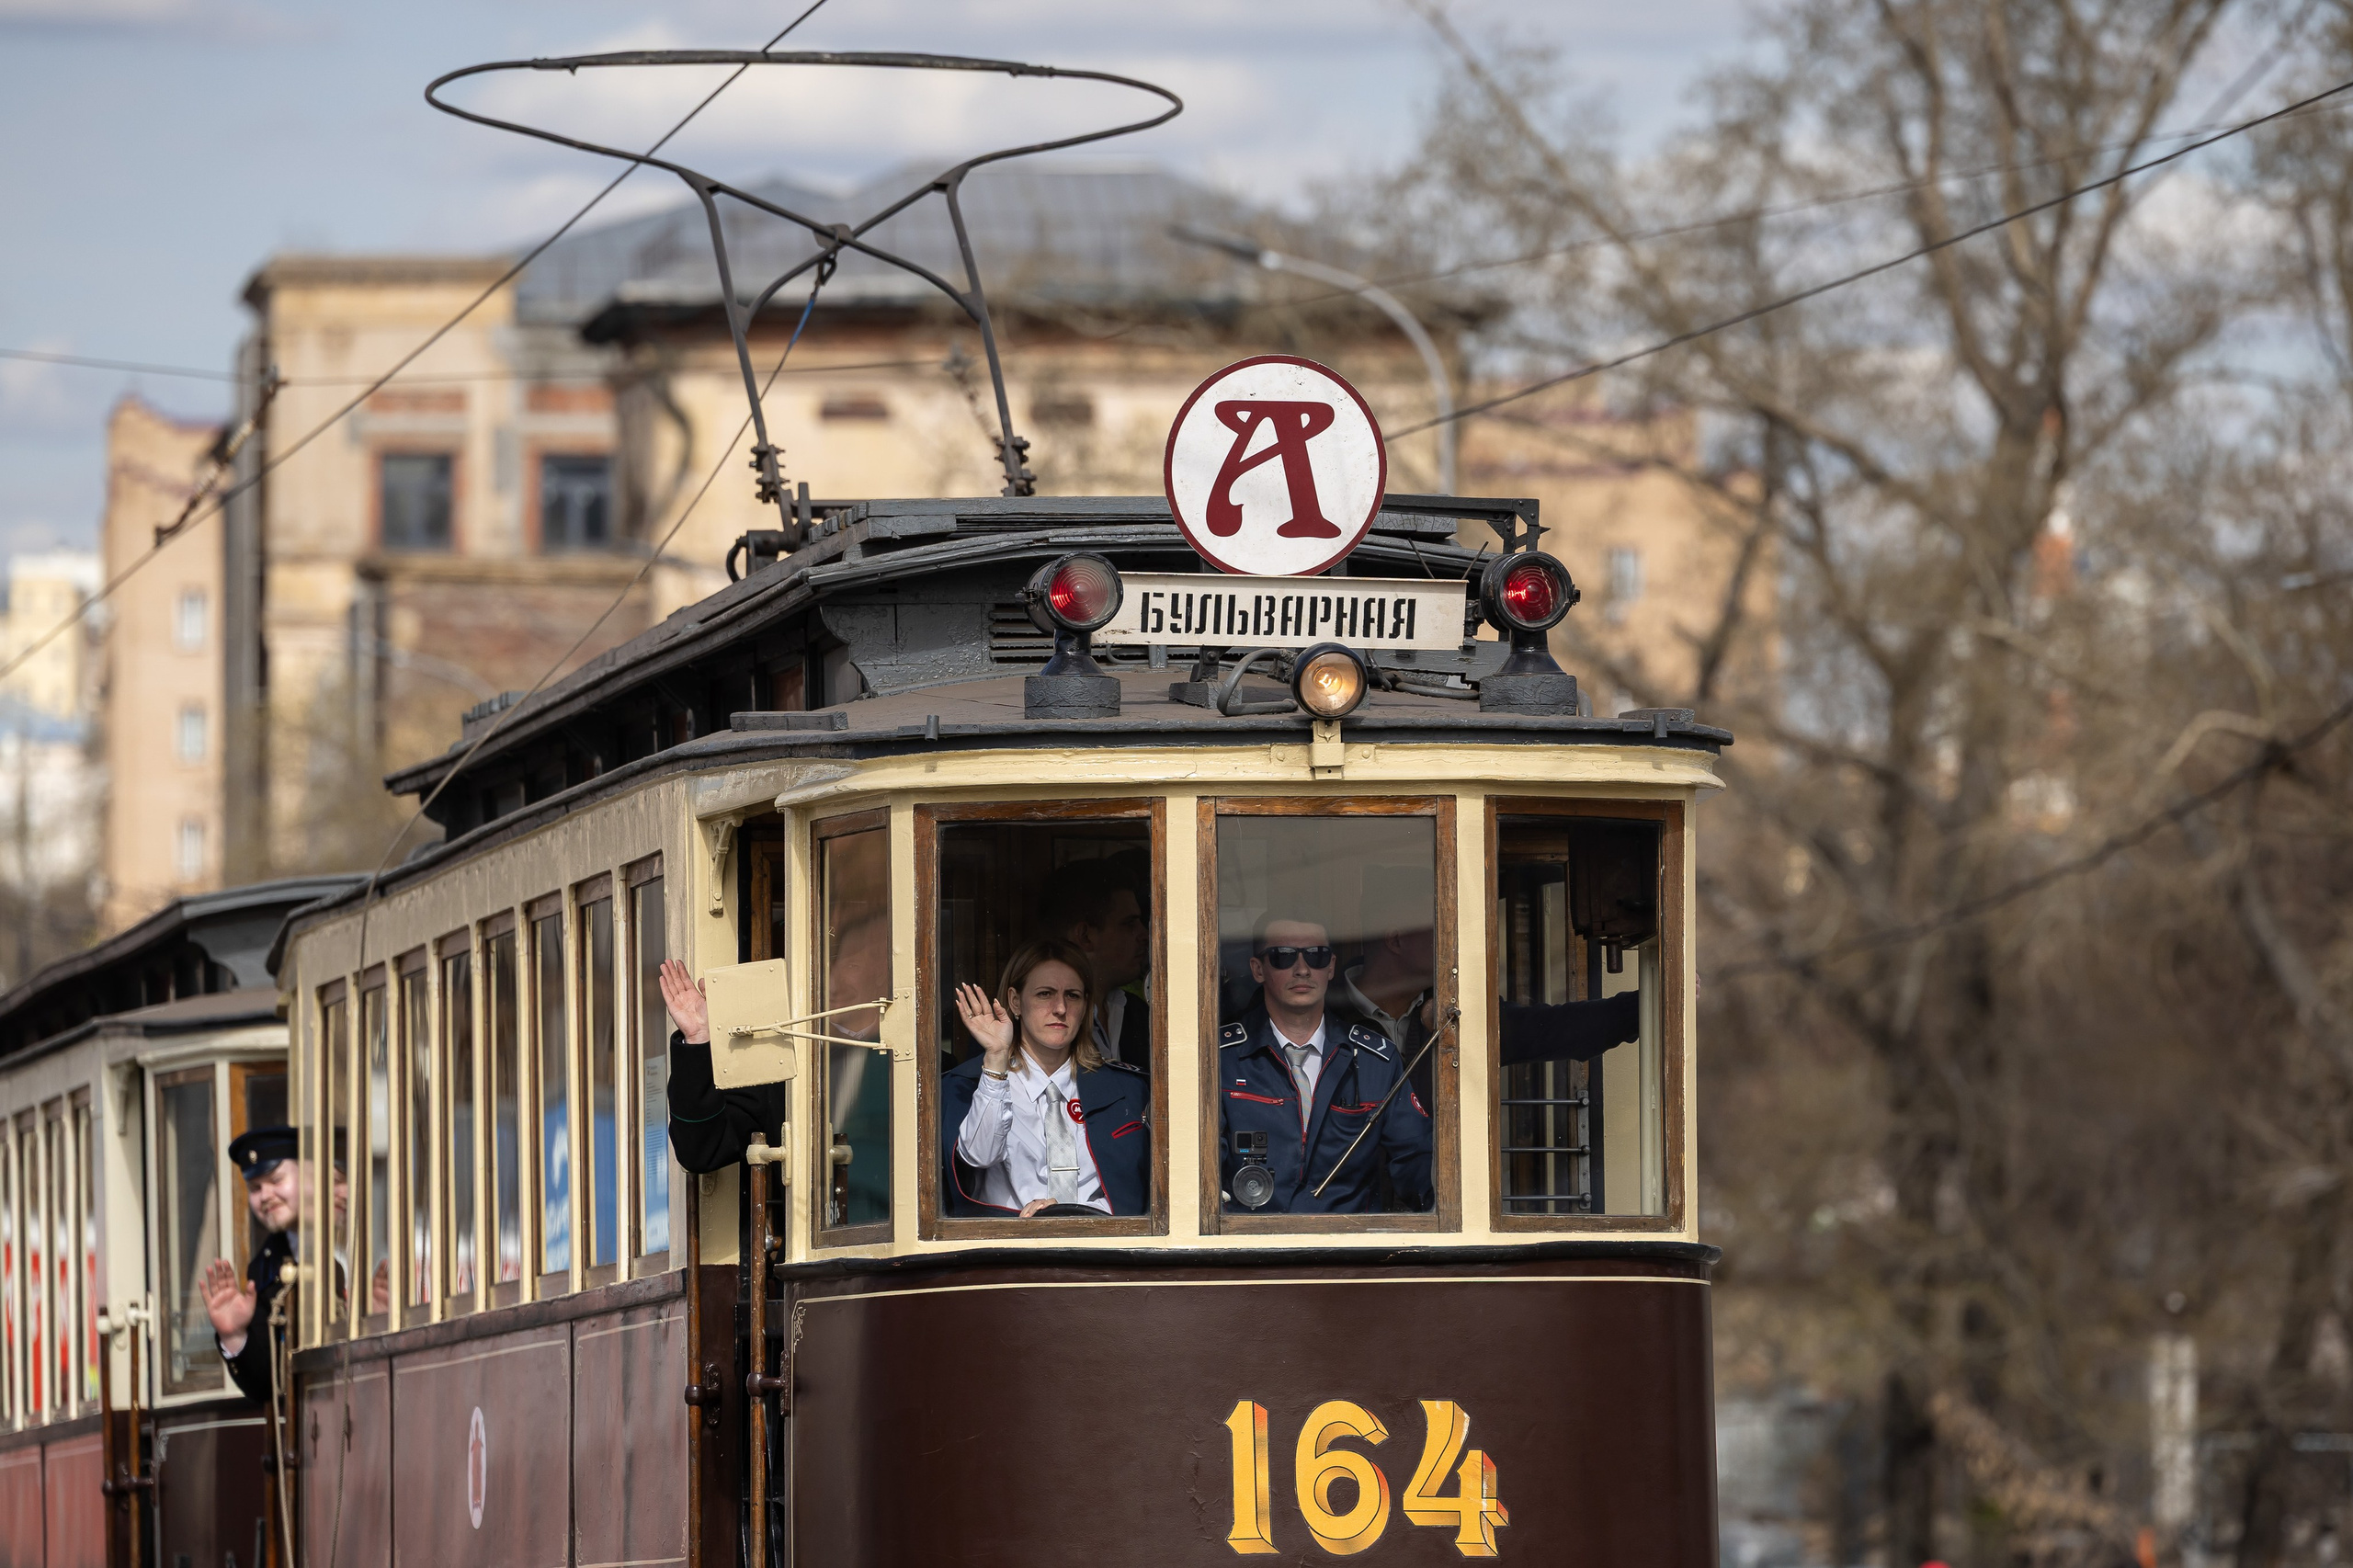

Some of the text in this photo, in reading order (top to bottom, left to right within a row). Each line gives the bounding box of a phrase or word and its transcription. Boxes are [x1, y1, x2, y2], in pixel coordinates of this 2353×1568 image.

[1206, 400, 1342, 539] А
[1141, 591, 1416, 640] БУЛЬВАРНАЯ
[1223, 1399, 1509, 1557] 164
